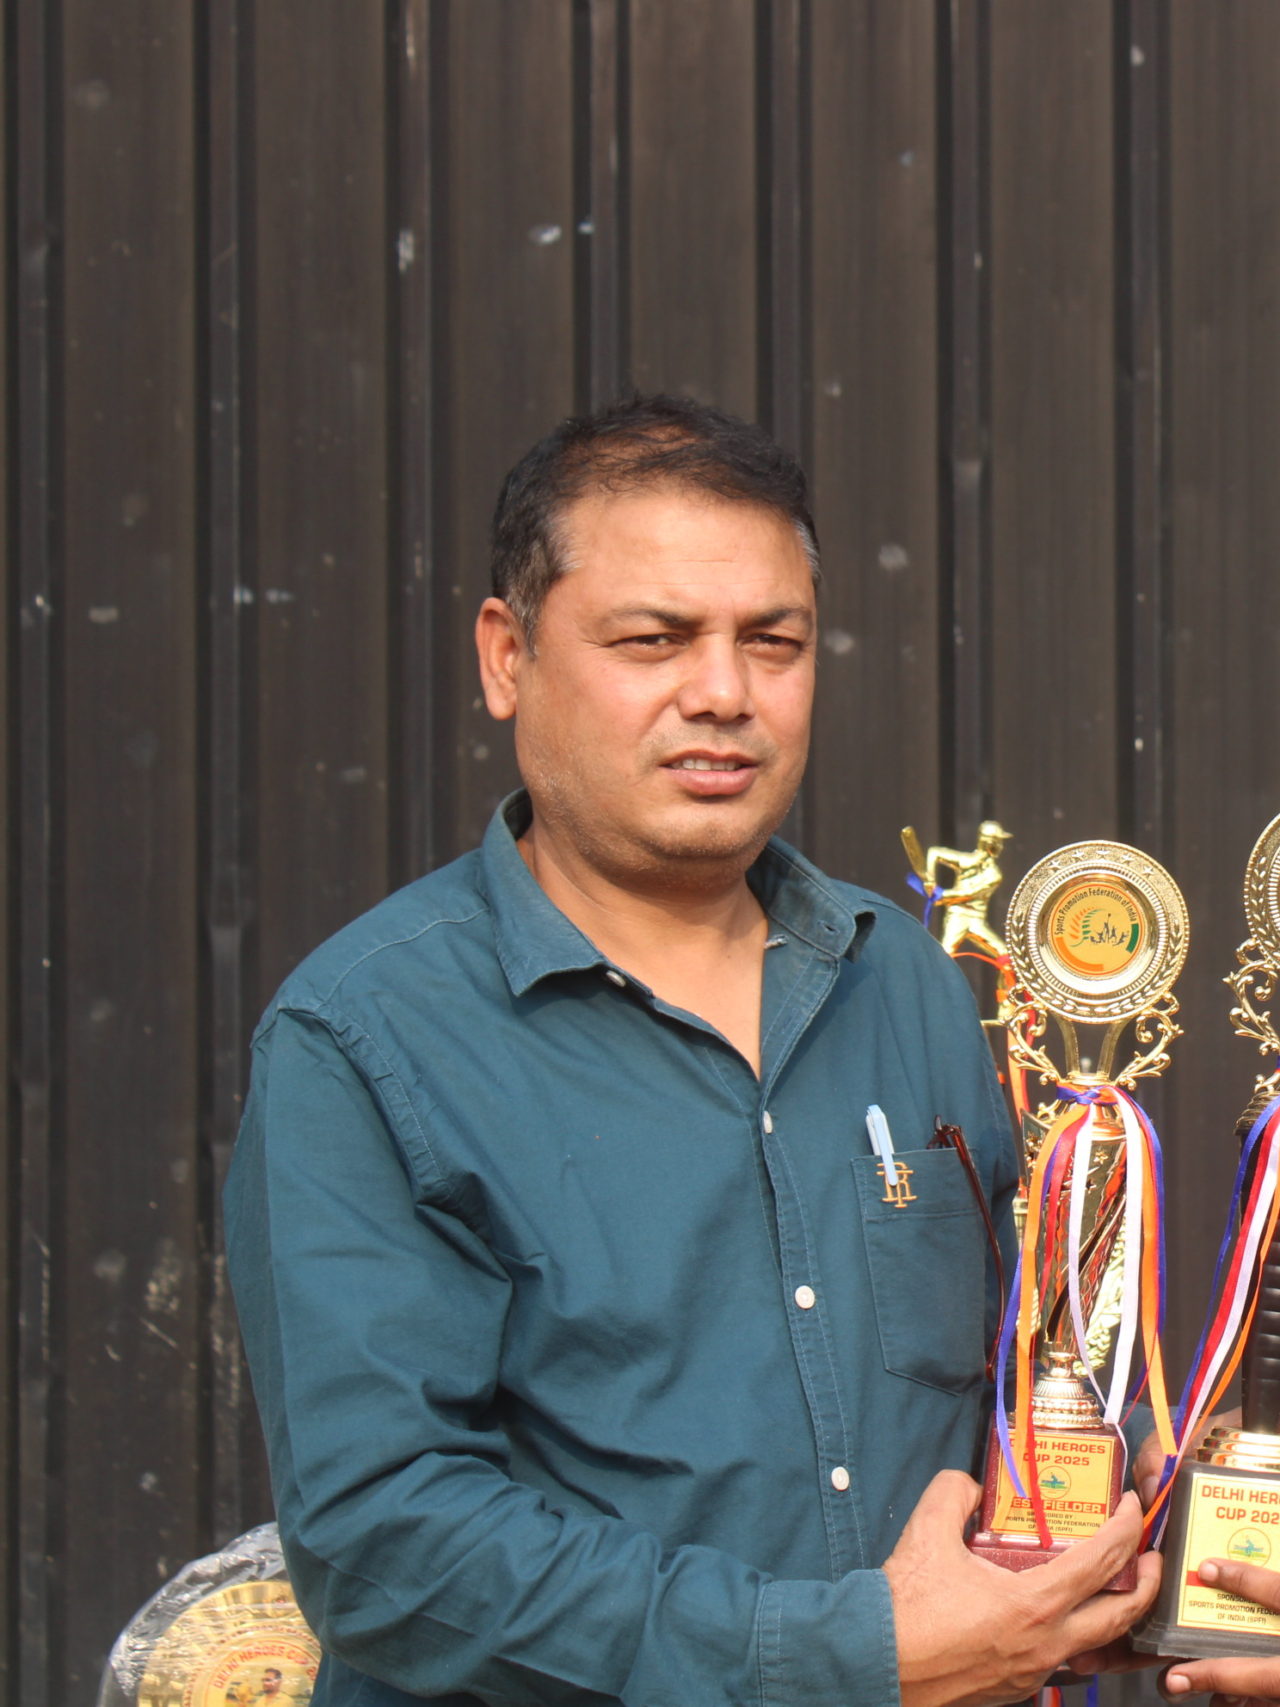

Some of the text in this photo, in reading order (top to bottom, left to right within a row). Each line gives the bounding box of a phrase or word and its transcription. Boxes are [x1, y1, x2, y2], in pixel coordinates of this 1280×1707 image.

[1054, 915, 1066, 935] Sports
[1061, 891, 1089, 916] Promotion
[1088, 887, 1123, 903] Federation
[1126, 905, 1137, 922] India
[1052, 1441, 1106, 1454] HEROES
[1054, 1455, 1090, 1466] 2025
[1202, 1485, 1244, 1500] DELHI
[1044, 1500, 1102, 1513] FIELDER
[1216, 1507, 1246, 1521] CUP
[1216, 1603, 1255, 1614] PROMOTION
